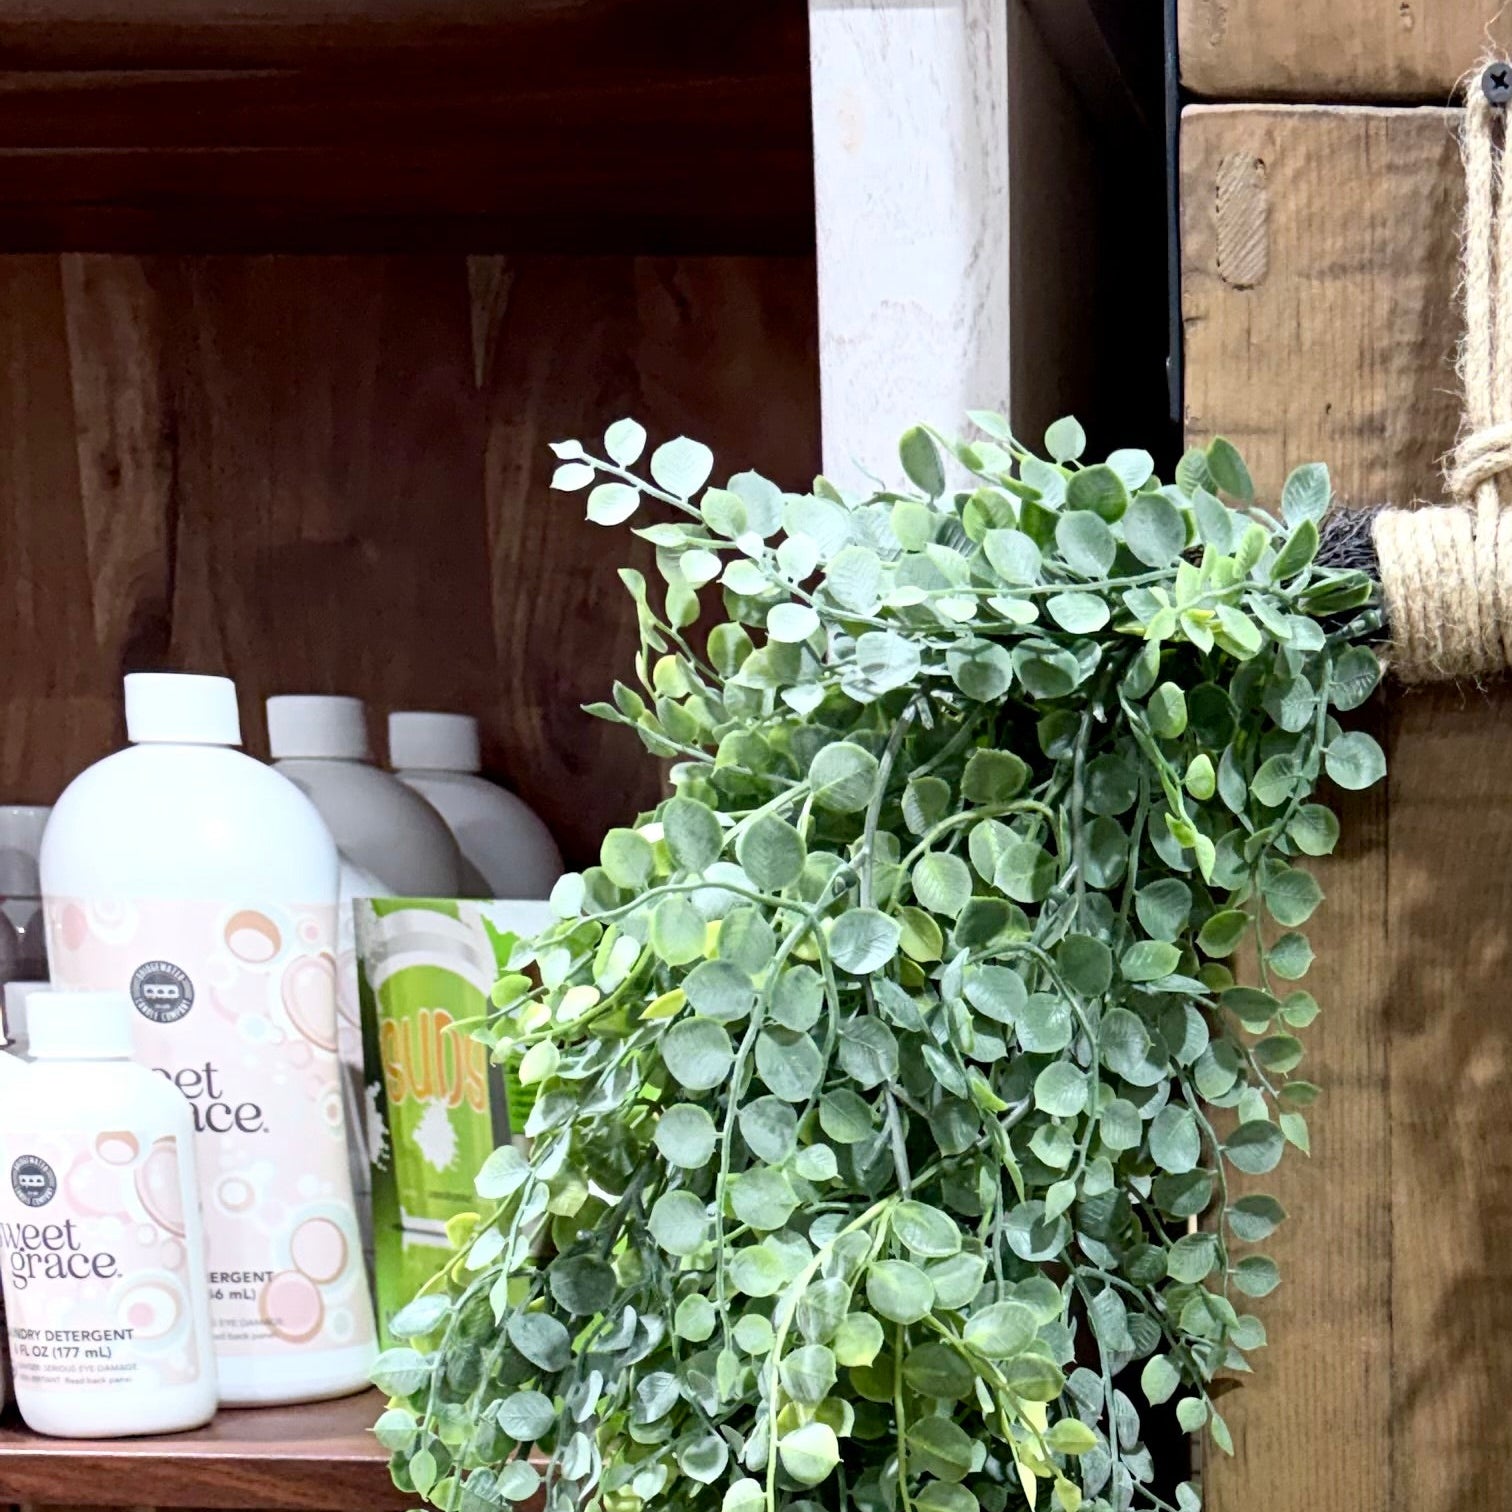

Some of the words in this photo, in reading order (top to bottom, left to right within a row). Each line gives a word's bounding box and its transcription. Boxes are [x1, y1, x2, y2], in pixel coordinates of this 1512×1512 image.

[0, 1219, 81, 1251] weet
[209, 1271, 273, 1284] ERGENT
[45, 1328, 134, 1342] DETERGENT
[32, 1345, 49, 1358] OZ
[52, 1346, 80, 1360] (177
[85, 1346, 112, 1359] mL)
